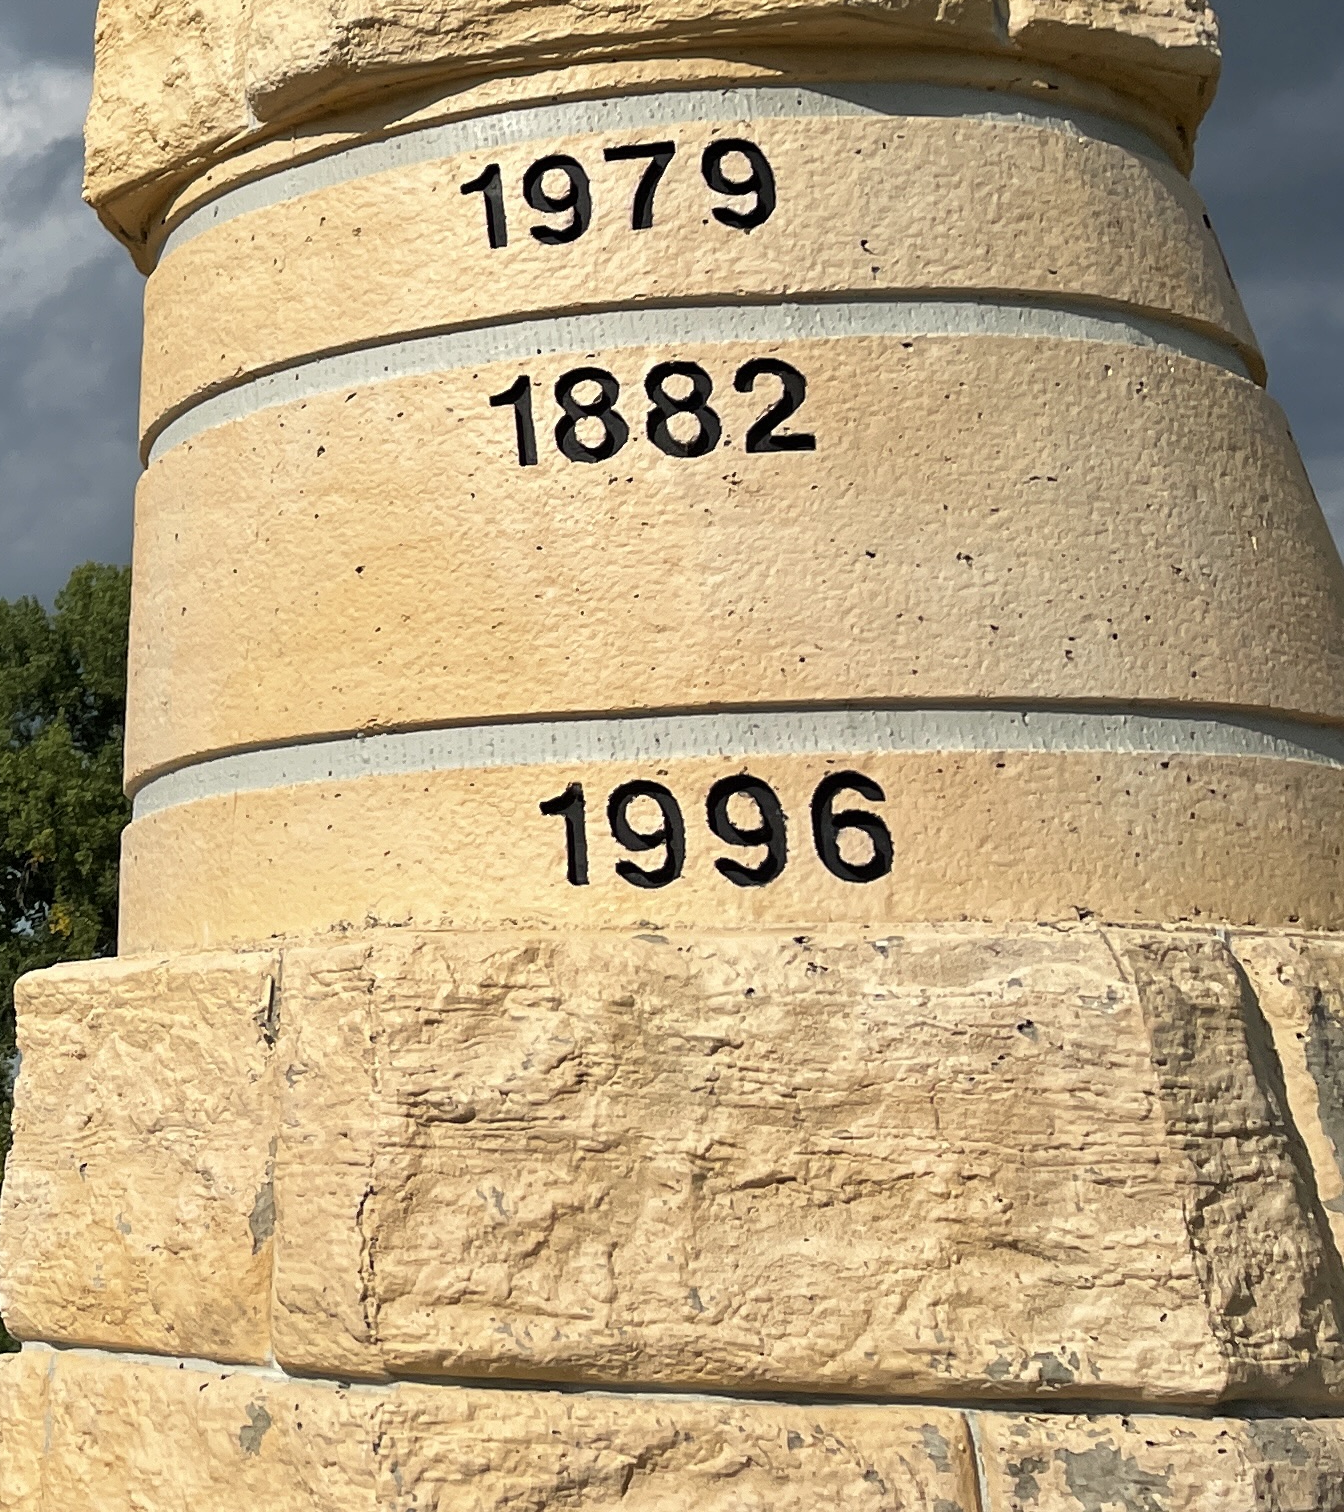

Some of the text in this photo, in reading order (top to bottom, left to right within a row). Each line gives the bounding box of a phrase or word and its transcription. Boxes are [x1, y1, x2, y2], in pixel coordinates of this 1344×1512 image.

[458, 137, 778, 251] 1979
[487, 356, 818, 468] 1882
[537, 769, 896, 889] 1996
